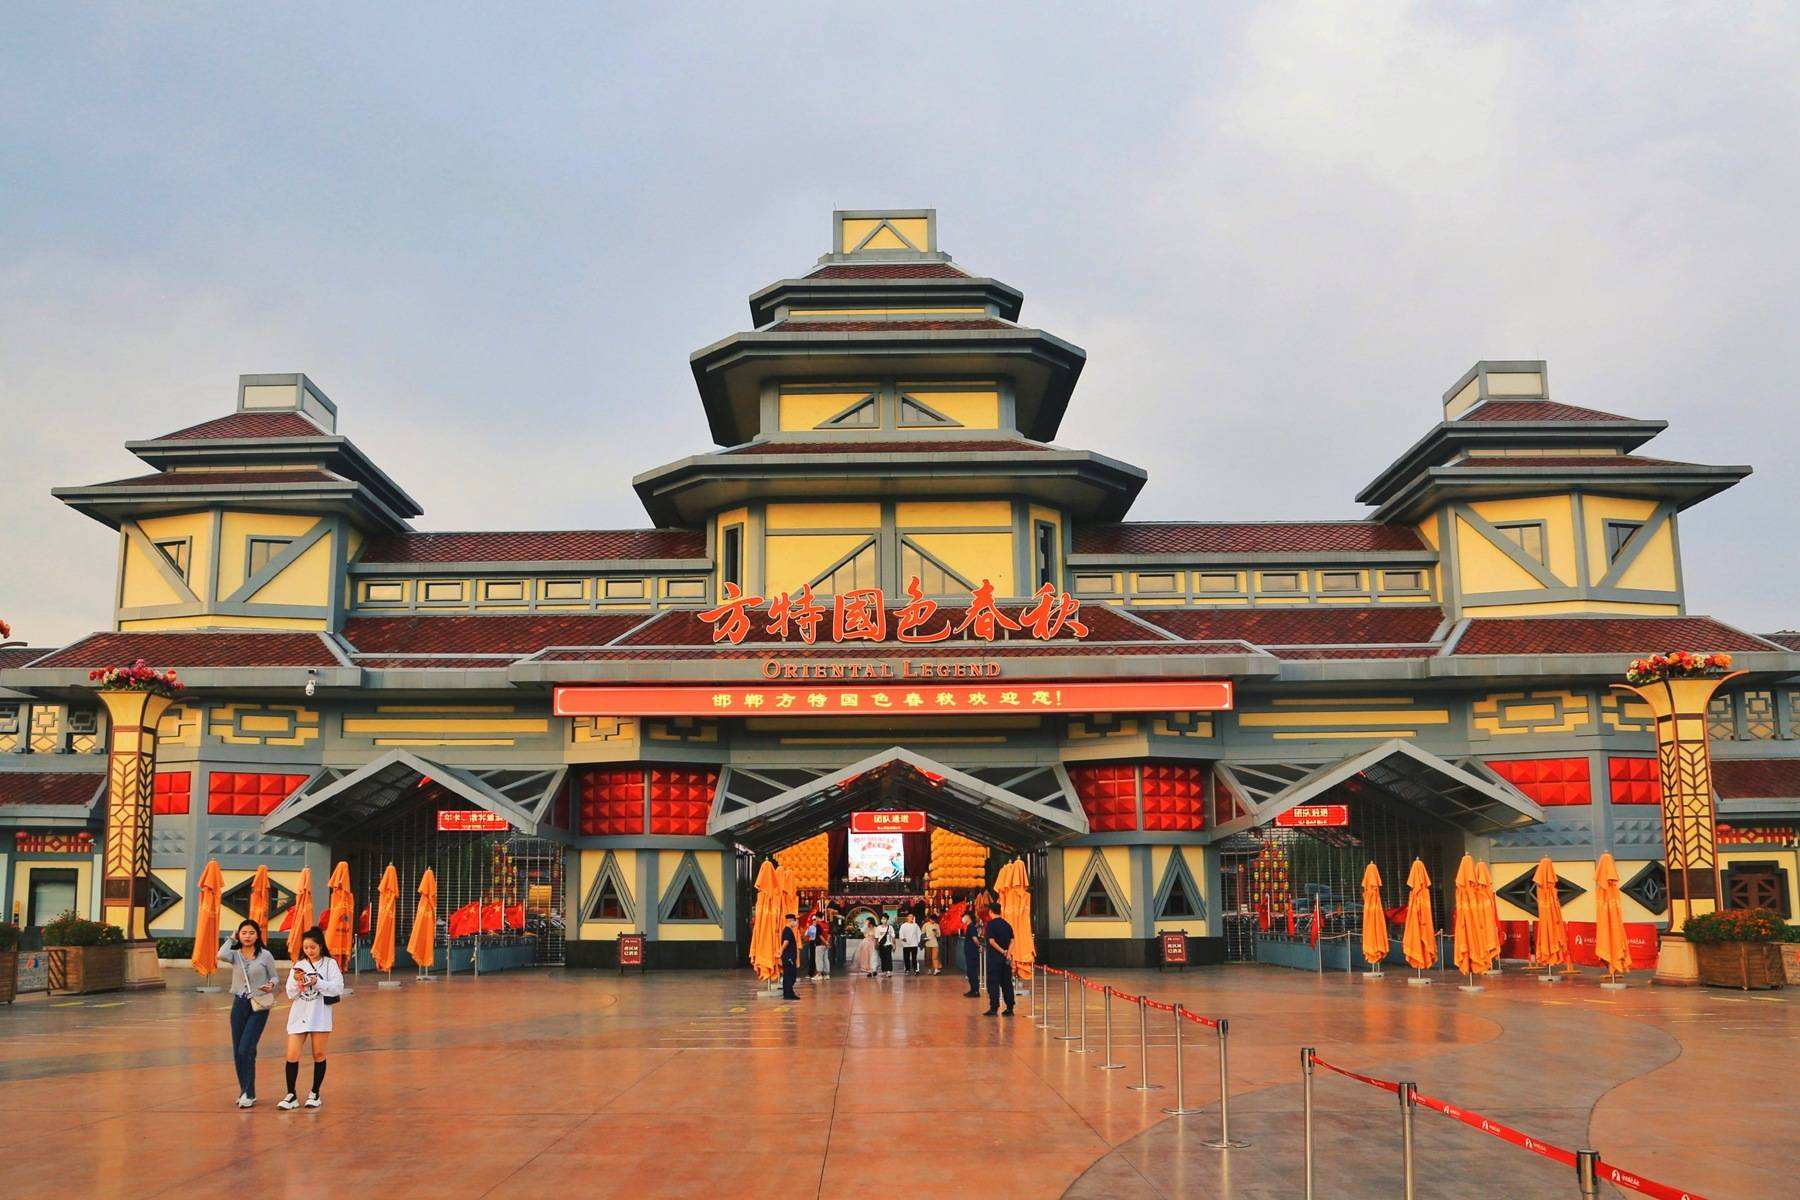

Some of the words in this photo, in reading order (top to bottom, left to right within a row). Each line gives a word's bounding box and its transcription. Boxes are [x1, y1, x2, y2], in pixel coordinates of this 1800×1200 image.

[697, 576, 1090, 644] 方特國色春秋
